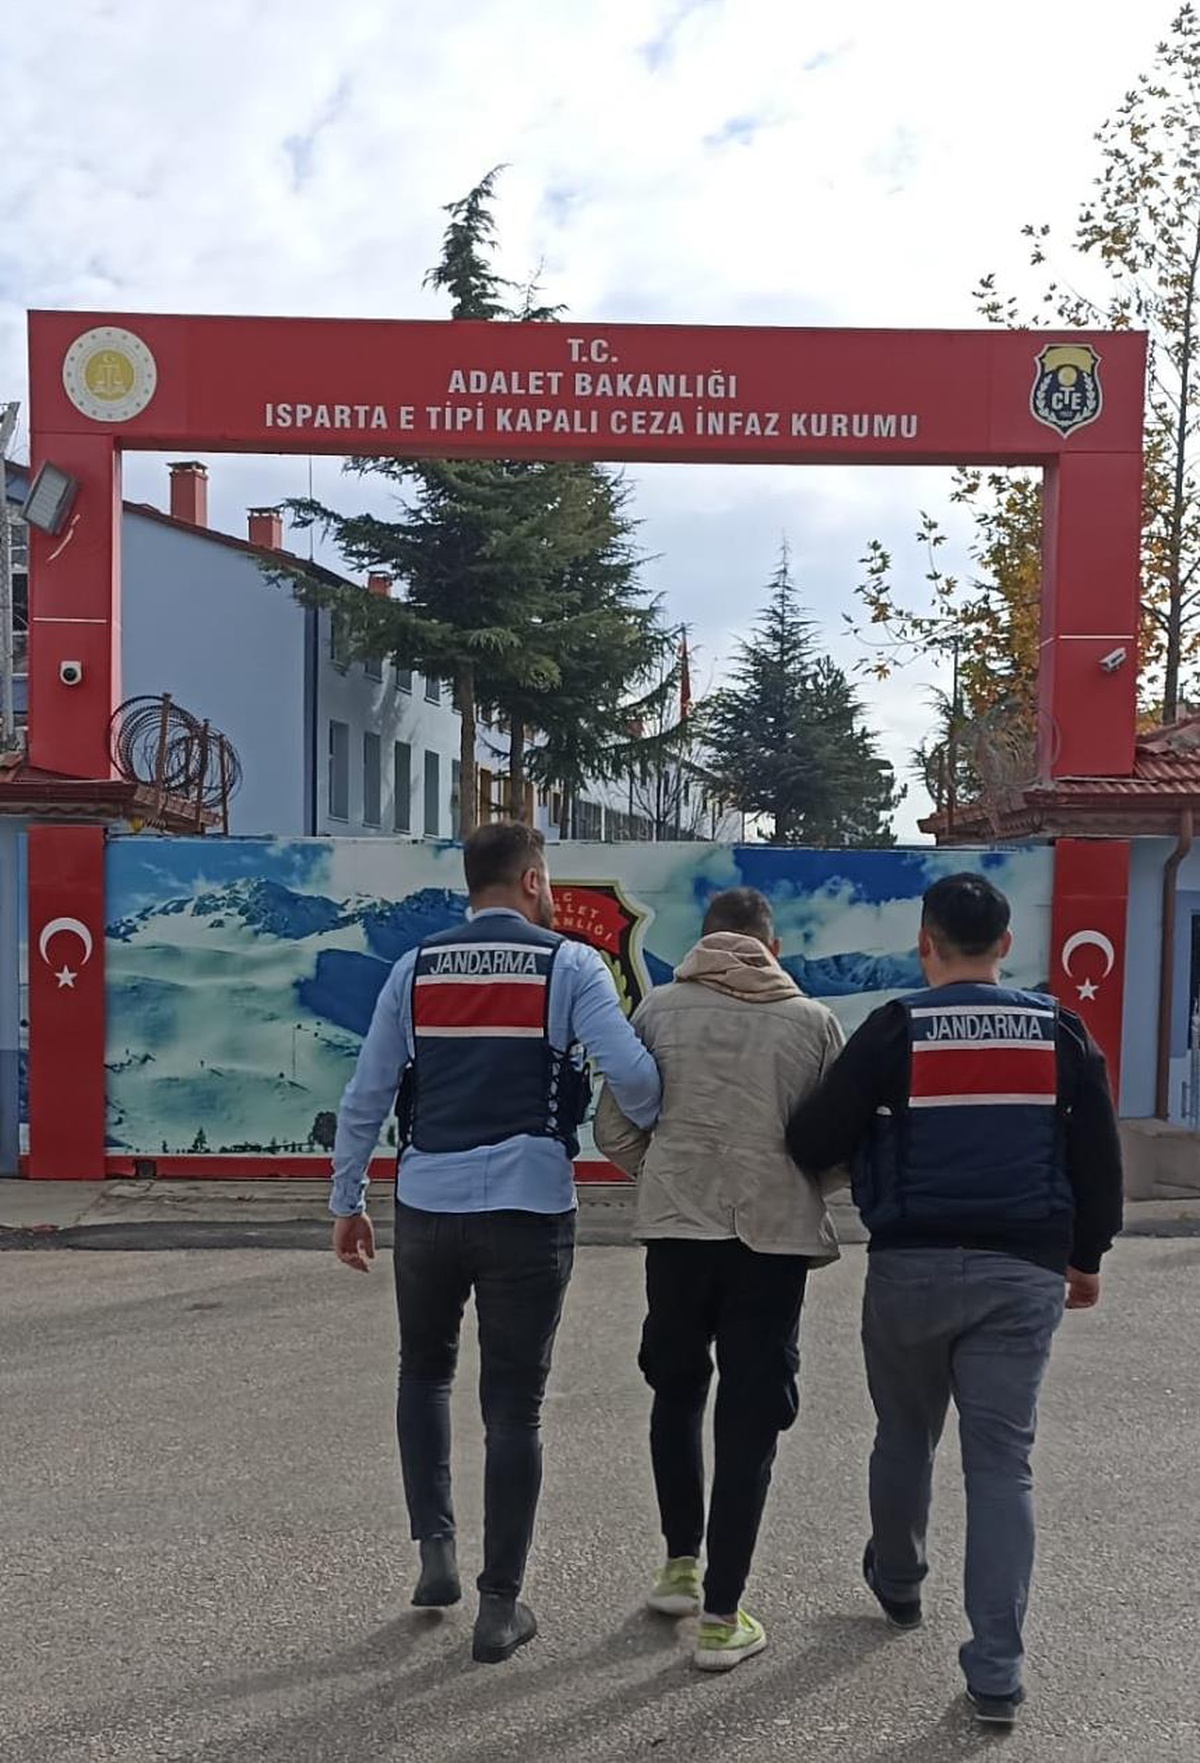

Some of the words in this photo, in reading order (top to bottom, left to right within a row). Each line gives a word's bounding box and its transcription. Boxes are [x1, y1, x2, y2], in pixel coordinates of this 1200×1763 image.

[567, 339, 618, 362] T.C.
[448, 370, 563, 395] ADALET
[574, 369, 737, 399] BAKANLIĞI
[265, 403, 388, 430] ISPARTA
[400, 406, 415, 430] E
[426, 402, 485, 432] TİPİ
[496, 408, 598, 434] KAPALI
[610, 409, 684, 436] CEZA
[696, 405, 780, 437] İNFAZ
[791, 412, 918, 439] KURUMU
[430, 950, 537, 974] JANDARMA
[926, 1015, 1043, 1040] JANDARMA
